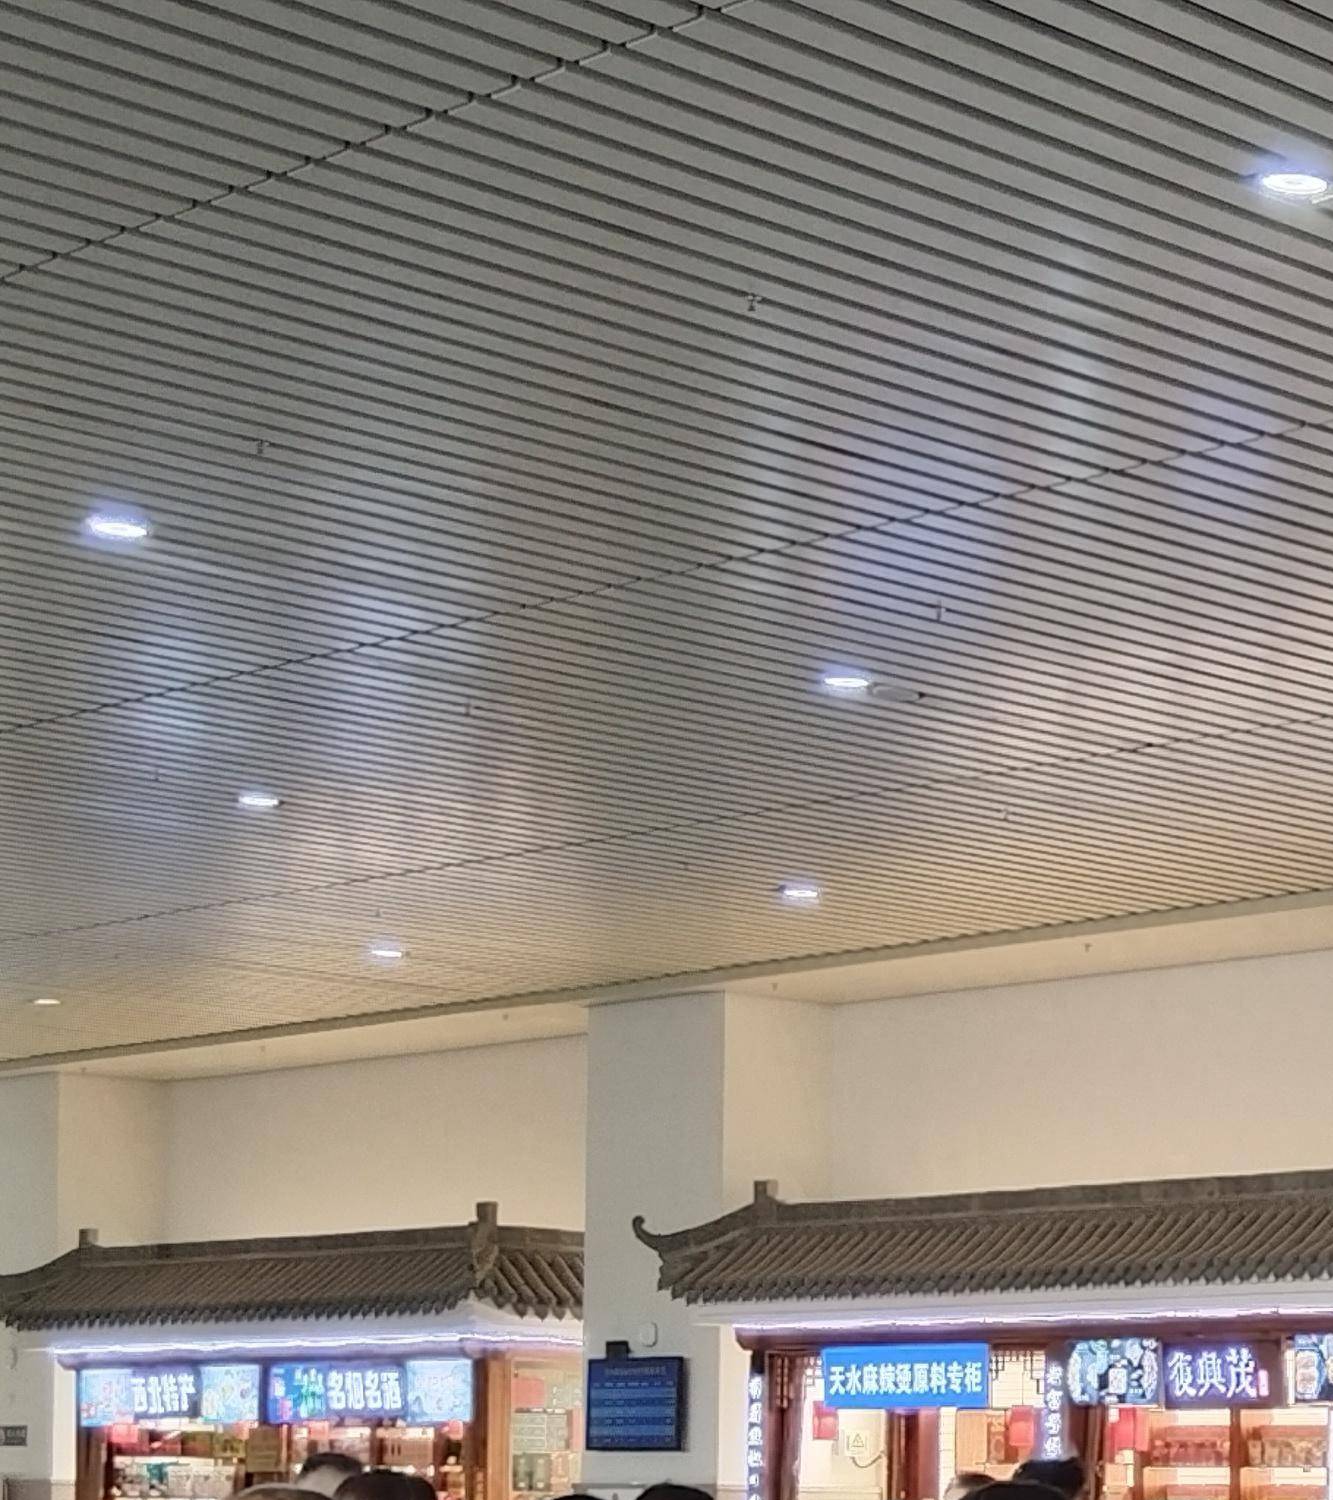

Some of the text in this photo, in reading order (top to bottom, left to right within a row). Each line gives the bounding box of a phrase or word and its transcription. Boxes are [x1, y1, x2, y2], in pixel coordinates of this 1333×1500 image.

[129, 1374, 197, 1414] 西北特产
[327, 1369, 401, 1410] 名烟名酒
[829, 1361, 983, 1395] 天水麻辣烫原料专柜
